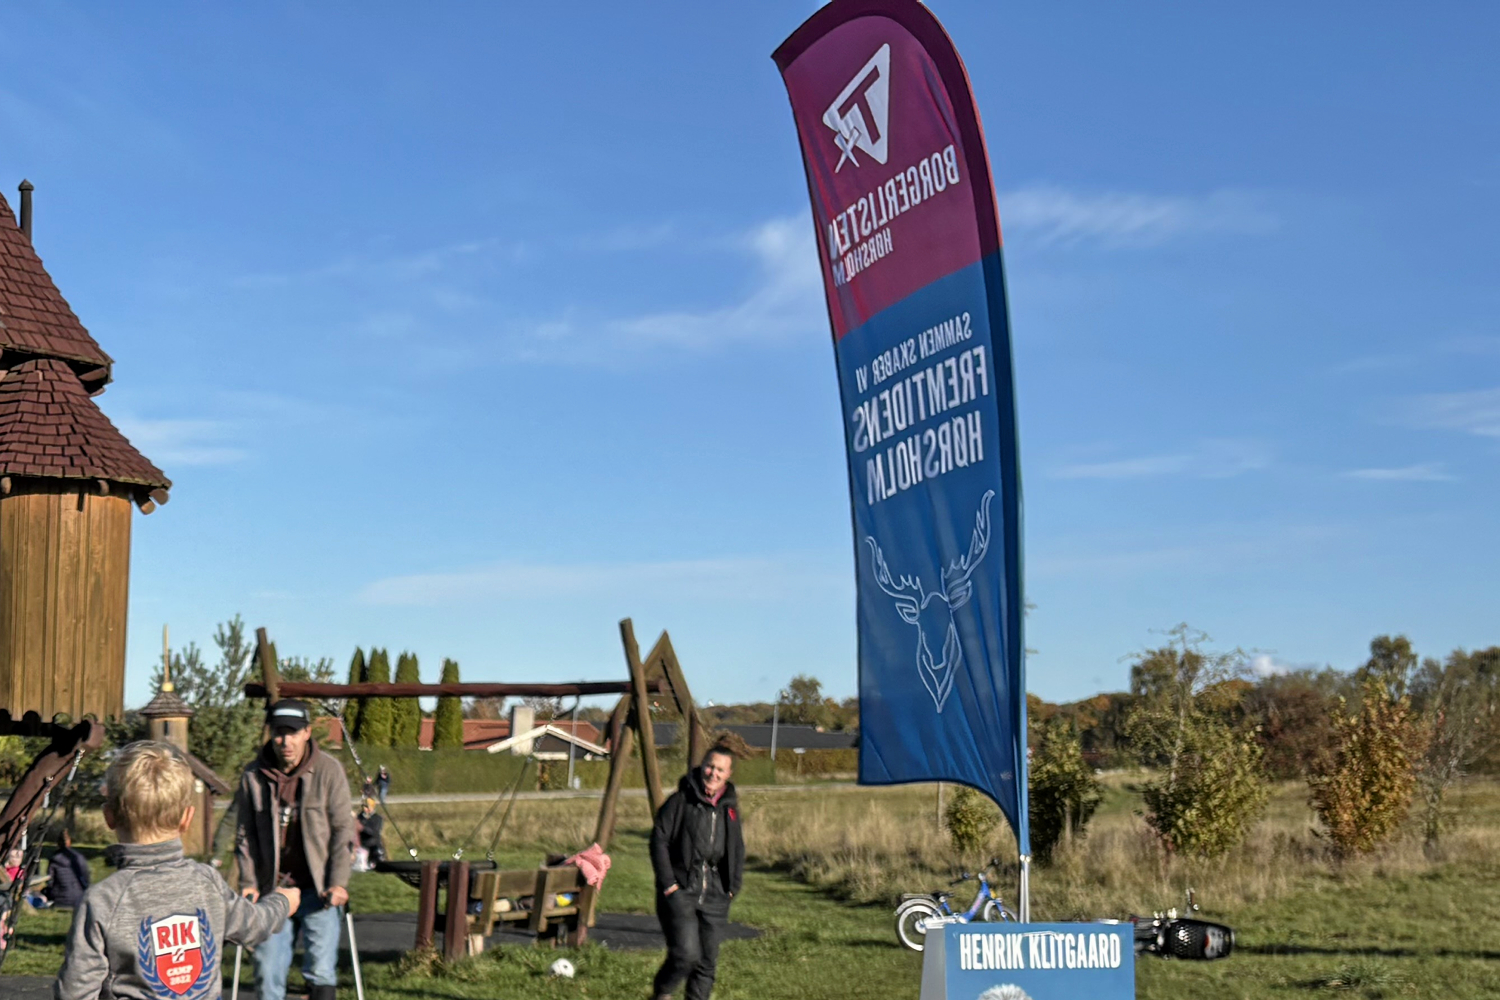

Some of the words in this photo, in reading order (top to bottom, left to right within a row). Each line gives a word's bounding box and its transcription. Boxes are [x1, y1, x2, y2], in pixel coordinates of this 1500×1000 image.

[156, 920, 197, 949] RIK
[959, 933, 1025, 970] HENRIK
[1028, 932, 1121, 969] KLITGAARD
